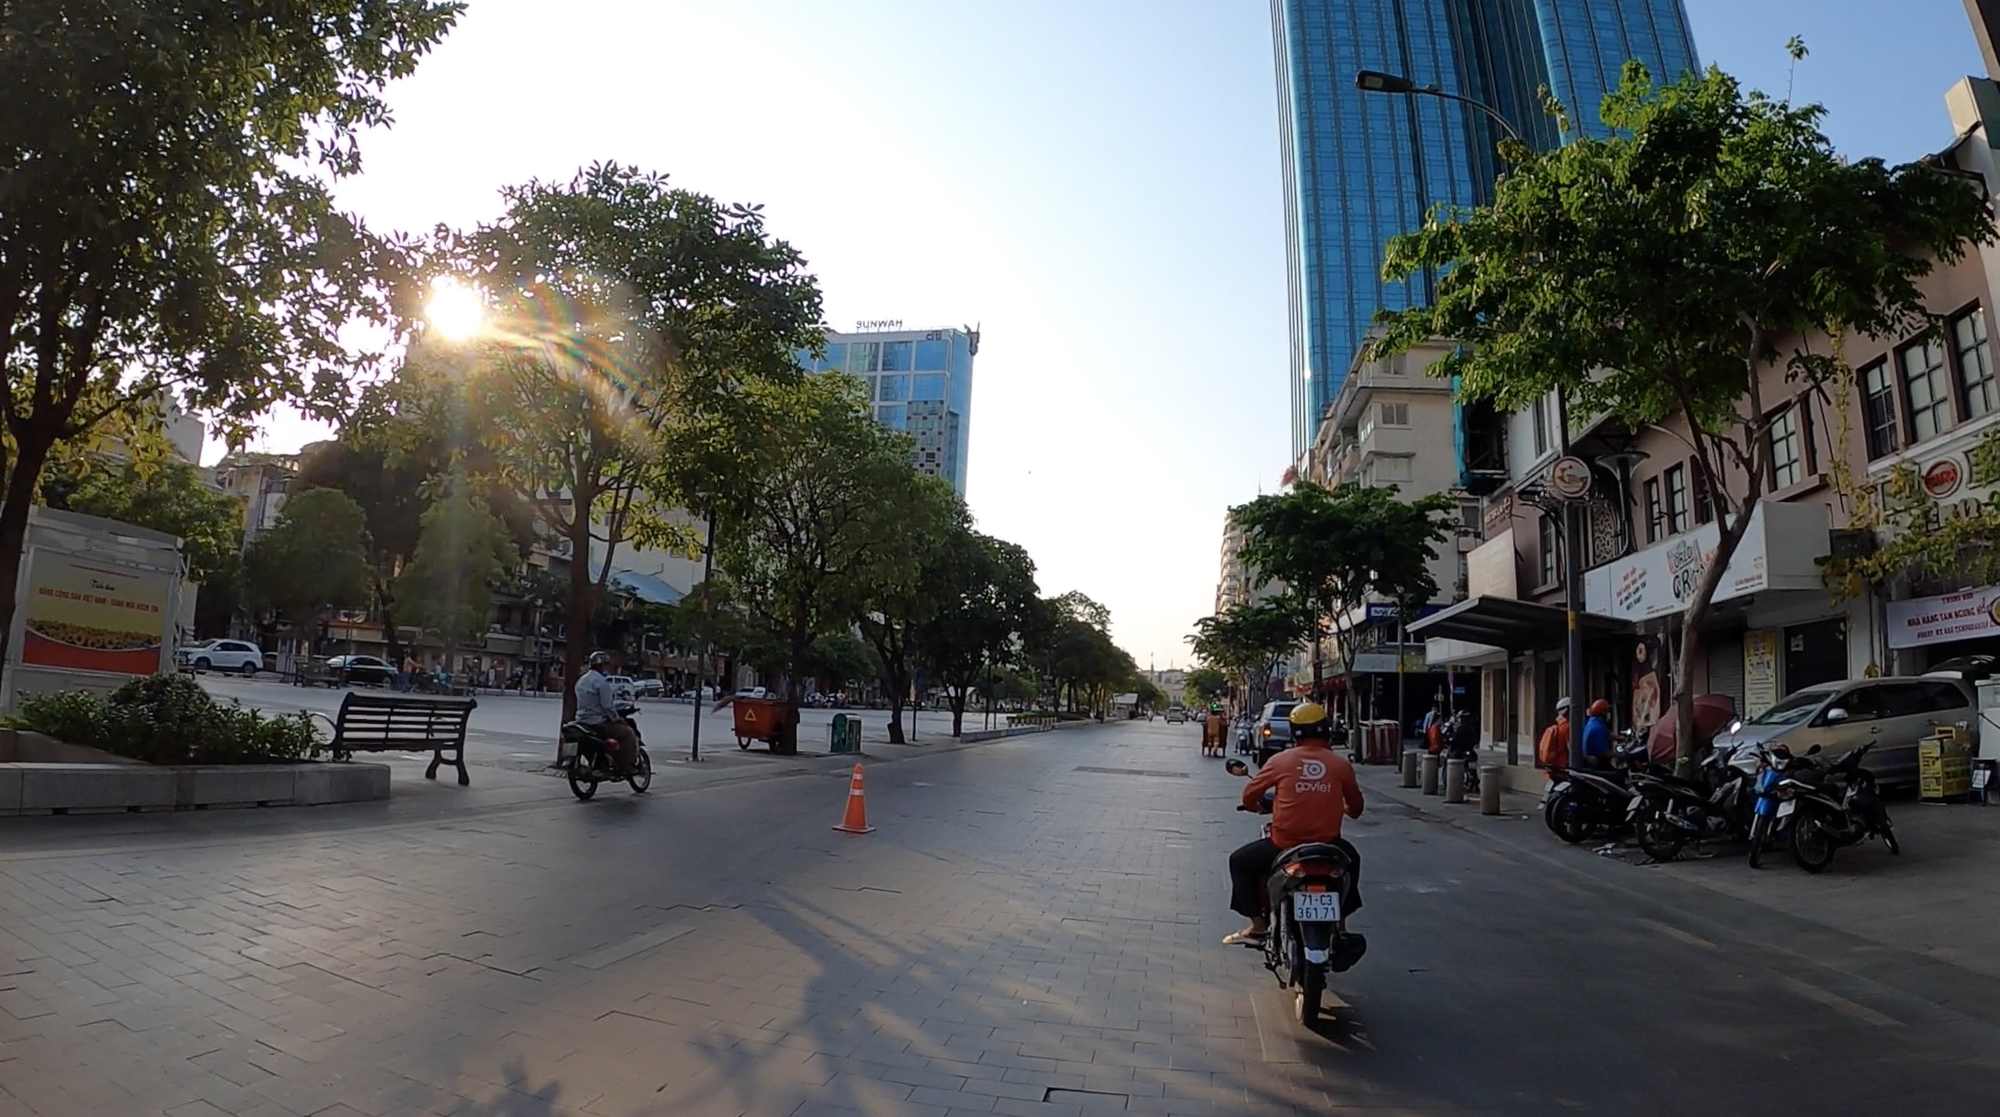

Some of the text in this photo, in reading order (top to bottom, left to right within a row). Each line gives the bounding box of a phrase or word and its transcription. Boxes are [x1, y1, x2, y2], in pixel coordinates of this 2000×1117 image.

[856, 319, 903, 329] SUNWAH
[1301, 894, 1332, 906] 71-C3
[1298, 907, 1336, 919] 361.71
